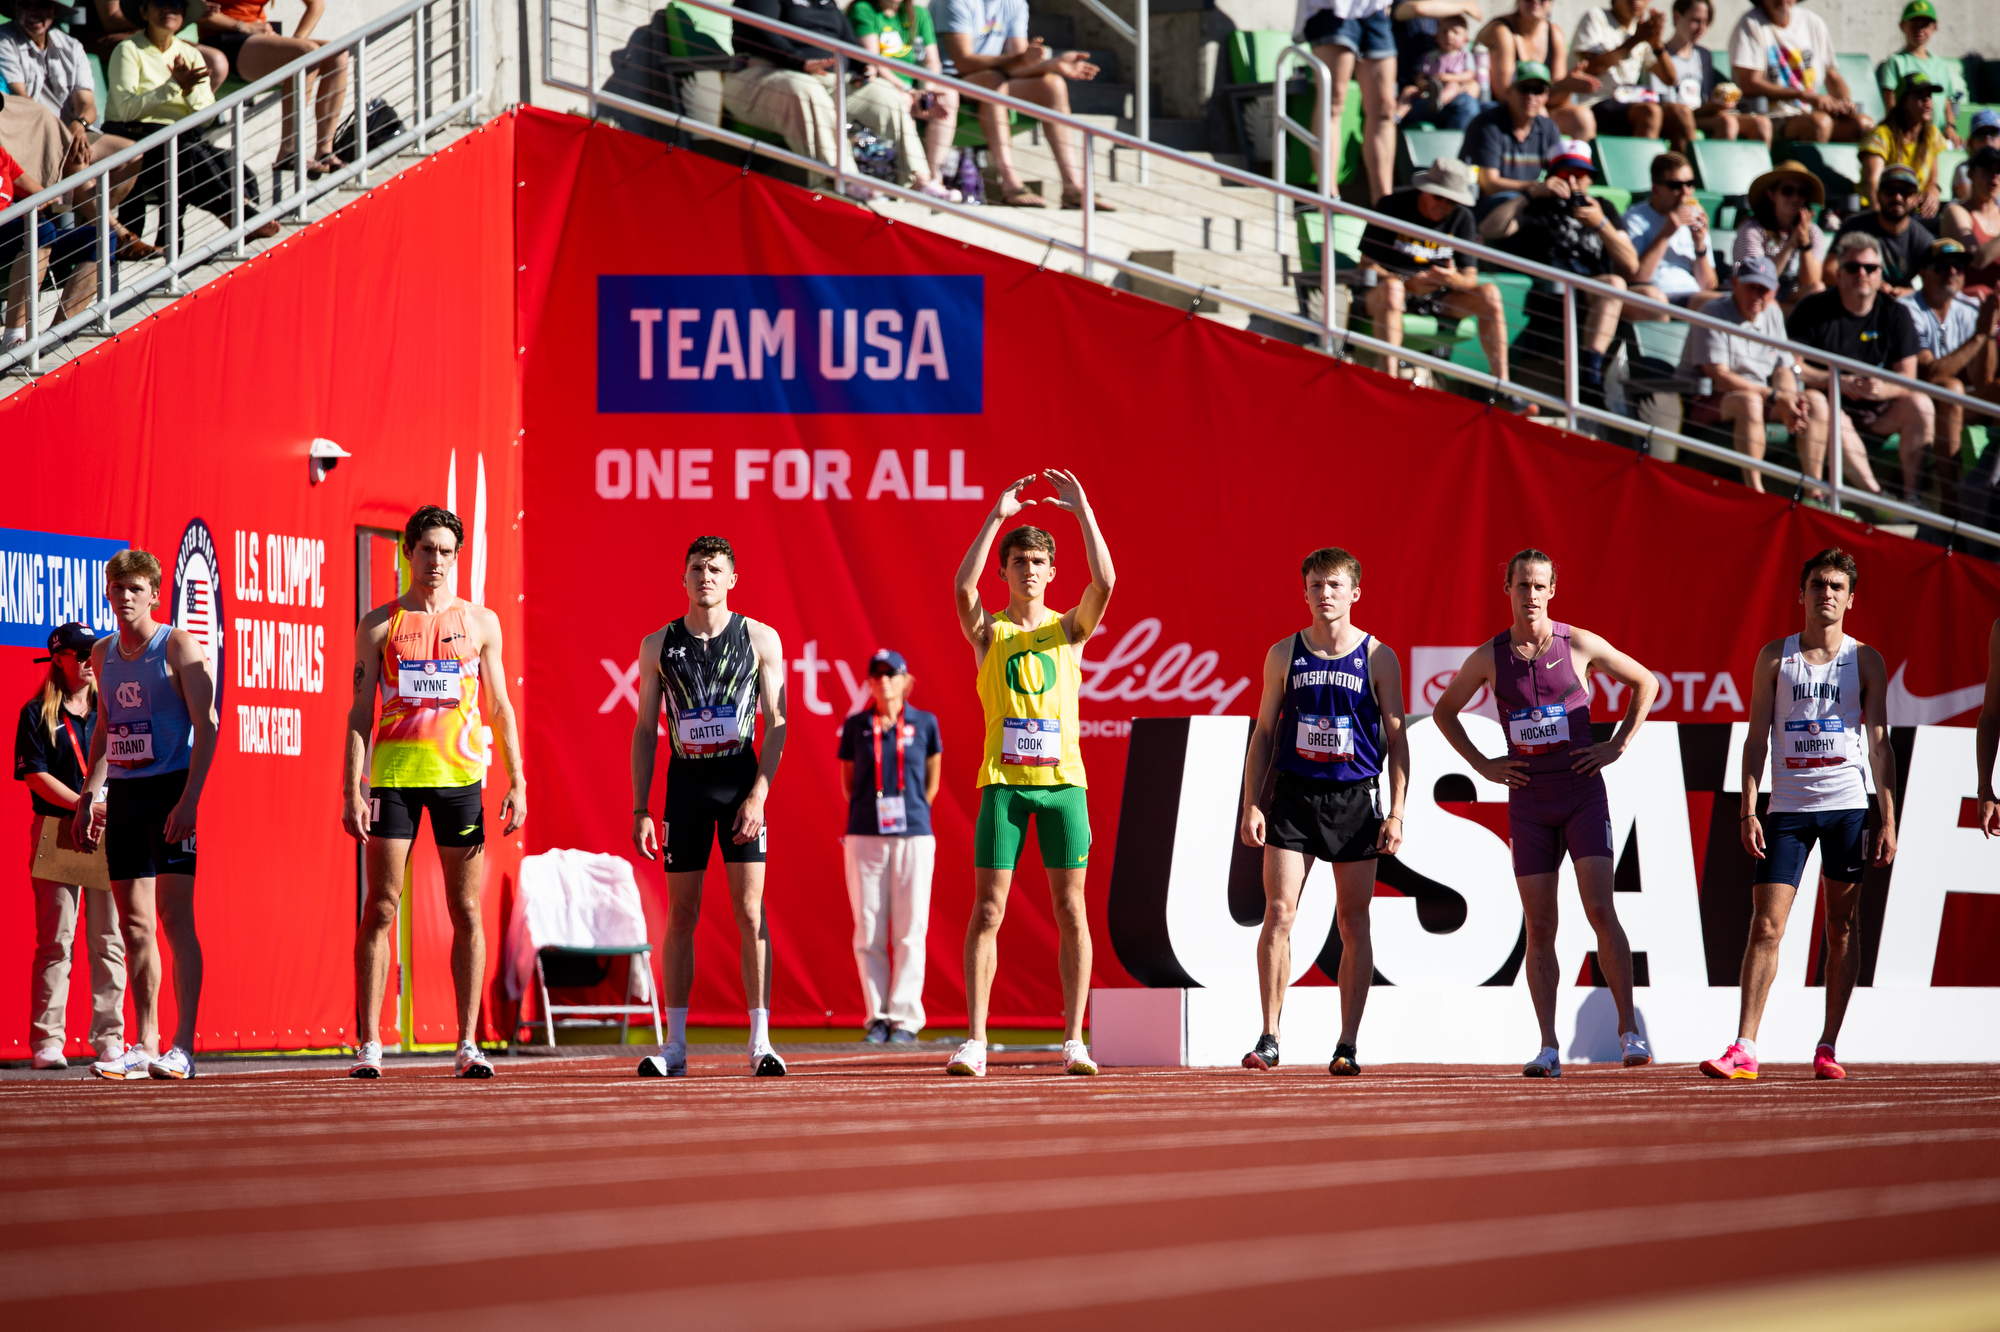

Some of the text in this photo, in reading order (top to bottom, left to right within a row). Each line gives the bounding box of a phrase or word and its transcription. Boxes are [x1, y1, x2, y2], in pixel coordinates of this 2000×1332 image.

[630, 308, 950, 381] TEAM USA
[595, 448, 984, 500] ONE FOR ALL
[175, 525, 219, 592] UNITED STATES
[235, 530, 325, 608] U.S. OLYMPIC
[0, 550, 118, 632] AKING TEAM US
[235, 618, 324, 693] TEAM TRIALS
[1079, 617, 1251, 716] Lilly
[413, 679, 448, 692] WYNNE
[1292, 670, 1363, 694] WASHINGTON
[1588, 670, 1744, 712] YOTA
[1792, 682, 1840, 704] VILLANOVA
[112, 739, 145, 755] STRAND
[237, 705, 270, 754] TRACK
[271, 707, 277, 755] &
[278, 708, 301, 756] FIELD
[690, 724, 725, 740] CIATTEI
[1017, 738, 1043, 750] COOK
[1308, 732, 1341, 747] GREEN
[1520, 723, 1558, 741] HOCKER
[1795, 738, 1835, 753] MURPHY
